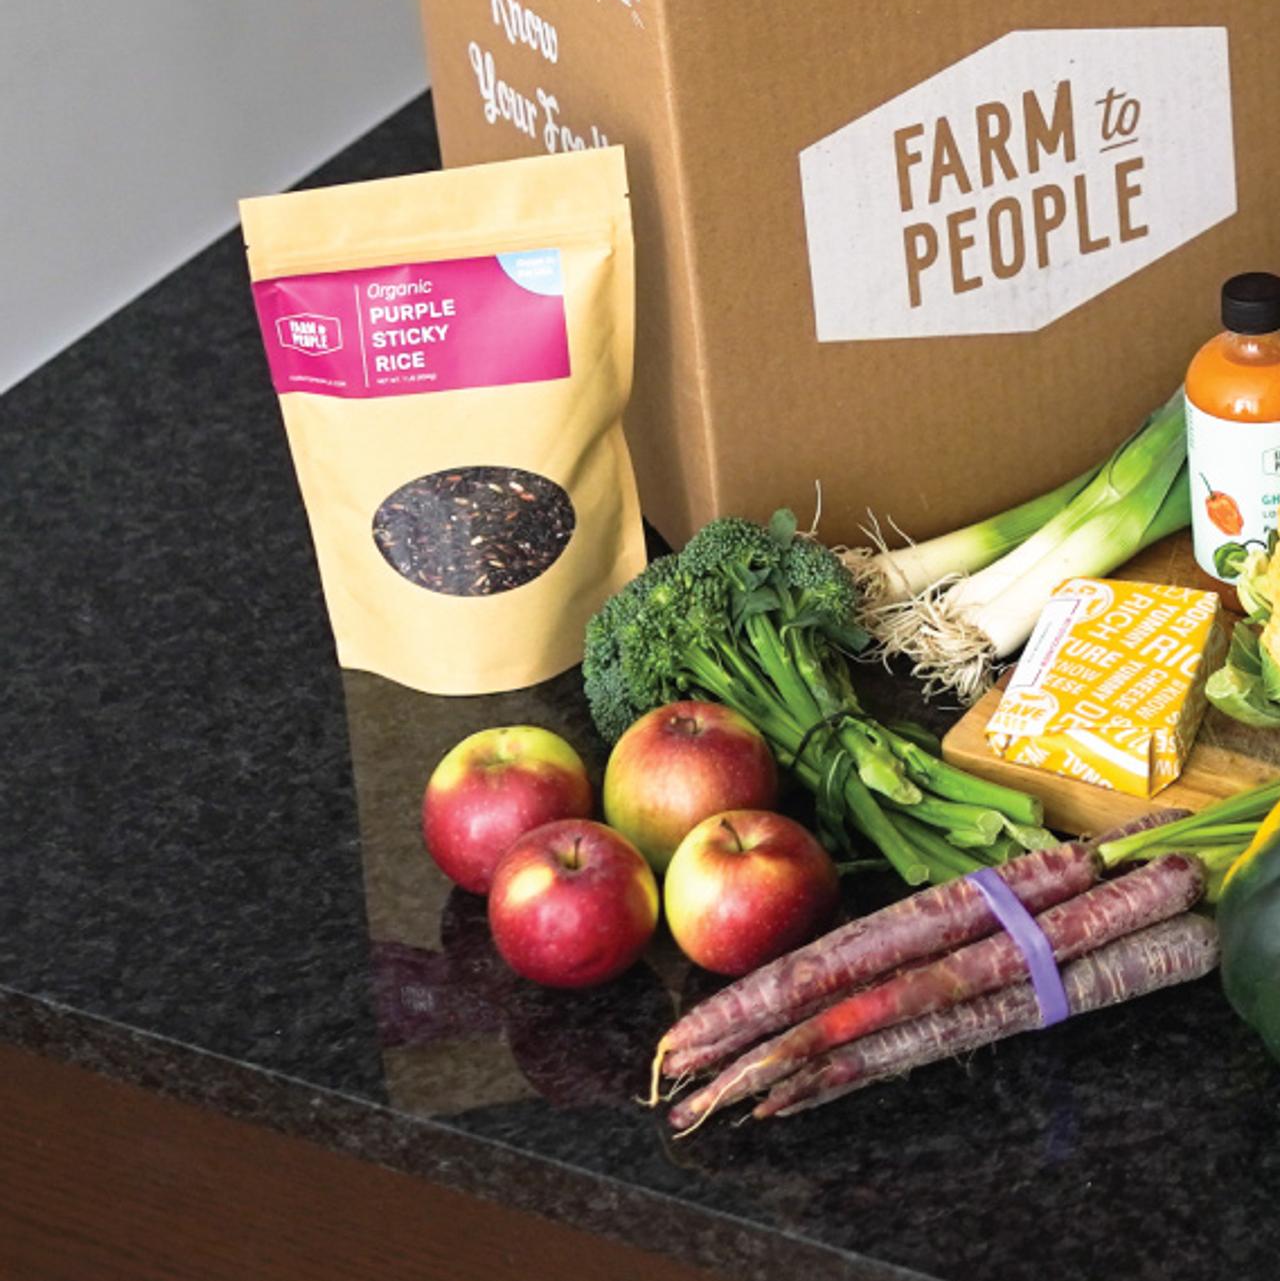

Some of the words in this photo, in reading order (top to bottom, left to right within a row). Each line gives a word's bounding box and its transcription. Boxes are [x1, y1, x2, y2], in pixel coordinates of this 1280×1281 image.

[467, 41, 537, 138] Your
[893, 79, 1077, 213] FARM
[1094, 87, 1142, 143] to
[902, 157, 1149, 309] PEOPLE
[366, 278, 433, 301] Organic
[369, 298, 456, 325] PURPLE
[371, 323, 449, 349] STICKY
[374, 351, 426, 372] RICE
[1087, 592, 1156, 641] RICH
